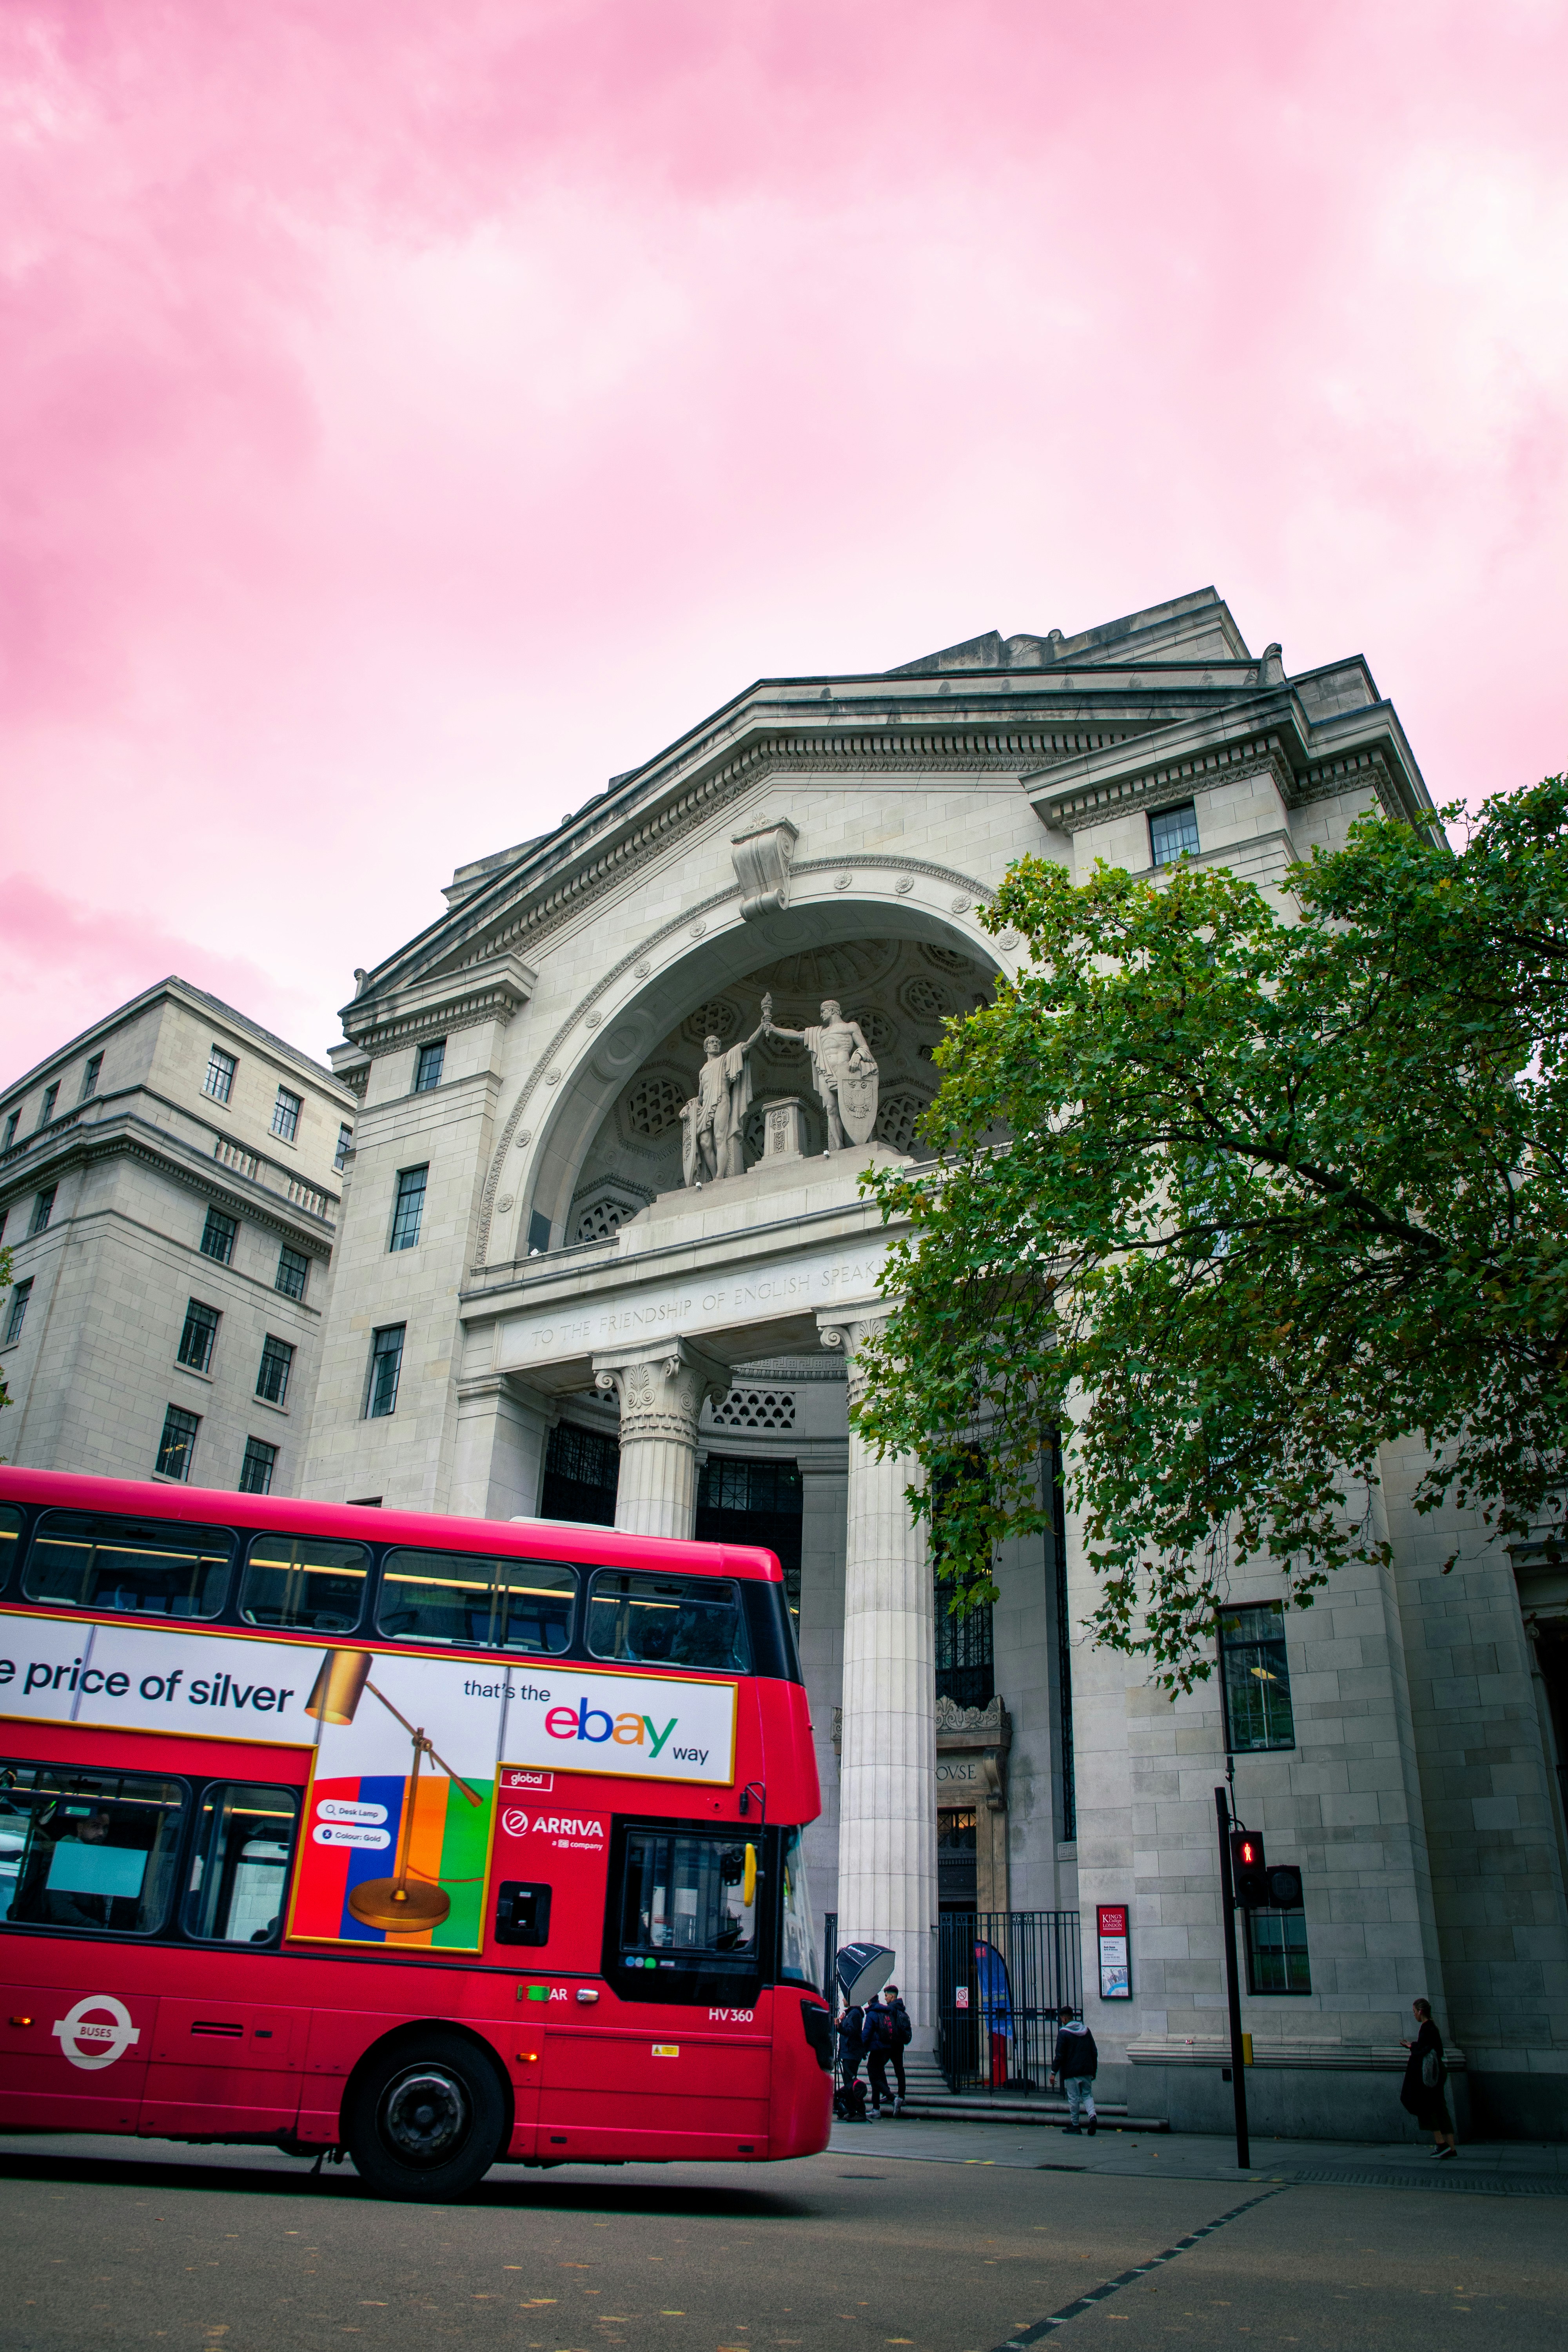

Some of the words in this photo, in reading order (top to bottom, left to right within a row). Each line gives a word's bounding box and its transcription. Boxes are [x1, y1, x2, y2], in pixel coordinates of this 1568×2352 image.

[531, 1329, 554, 1346] TO
[560, 1321, 590, 1340] THE
[599, 1300, 691, 1332] FRIENDSHIP
[702, 1292, 725, 1310] OF
[734, 1274, 810, 1305] ENGLISH
[822, 1259, 887, 1286] SPEAKI
[24, 1658, 130, 1696] price
[140, 1670, 183, 1701] of
[189, 1673, 294, 1712] silver
[464, 1680, 515, 1699] that's
[521, 1684, 550, 1702] the
[545, 1697, 678, 1758] ebay
[673, 1747, 709, 1765] way
[511, 1772, 543, 1786] global
[936, 1764, 976, 1780] OVSE
[359, 1809, 379, 1818] Lamp
[532, 1817, 604, 1837] ARRIVA
[335, 1832, 362, 1840] Colour:
[570, 1842, 603, 1851] company
[1102, 1914, 1122, 1923] KING'S
[549, 1988, 568, 2000] AR
[80, 2026, 112, 2038] BUSES
